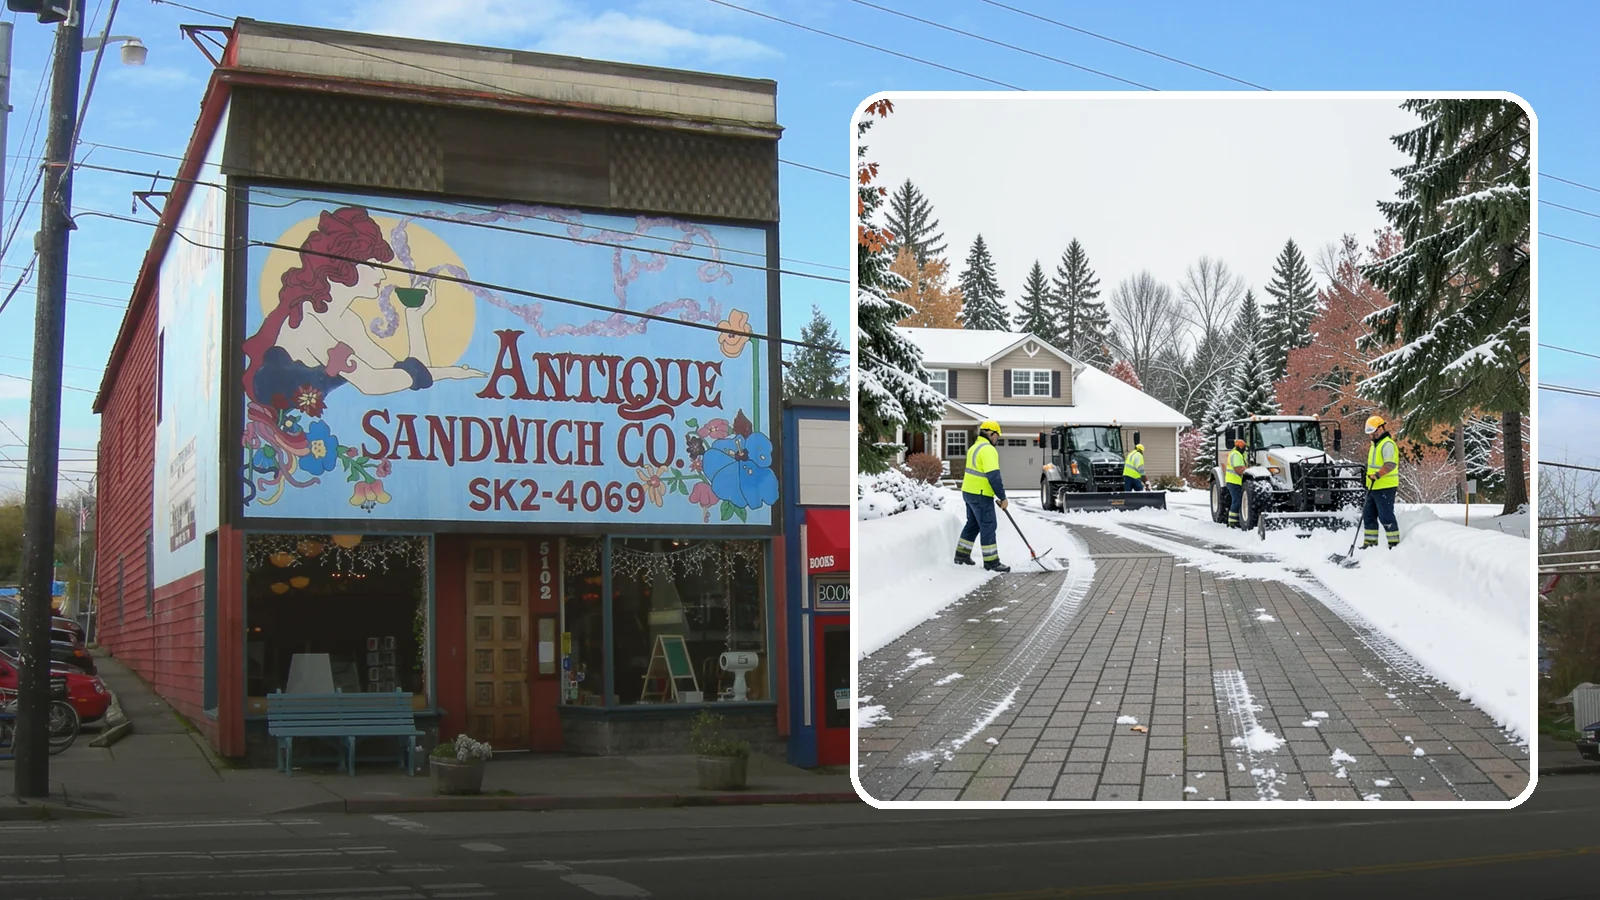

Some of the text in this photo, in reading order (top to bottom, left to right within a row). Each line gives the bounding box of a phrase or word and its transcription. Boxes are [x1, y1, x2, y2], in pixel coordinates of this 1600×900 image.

[476, 328, 724, 421] ANTIQUE
[361, 408, 685, 469] SANDWICH CO.
[468, 477, 646, 513] SK2-4069
[540, 542, 551, 599] 5102
[810, 555, 835, 569] BOOKS
